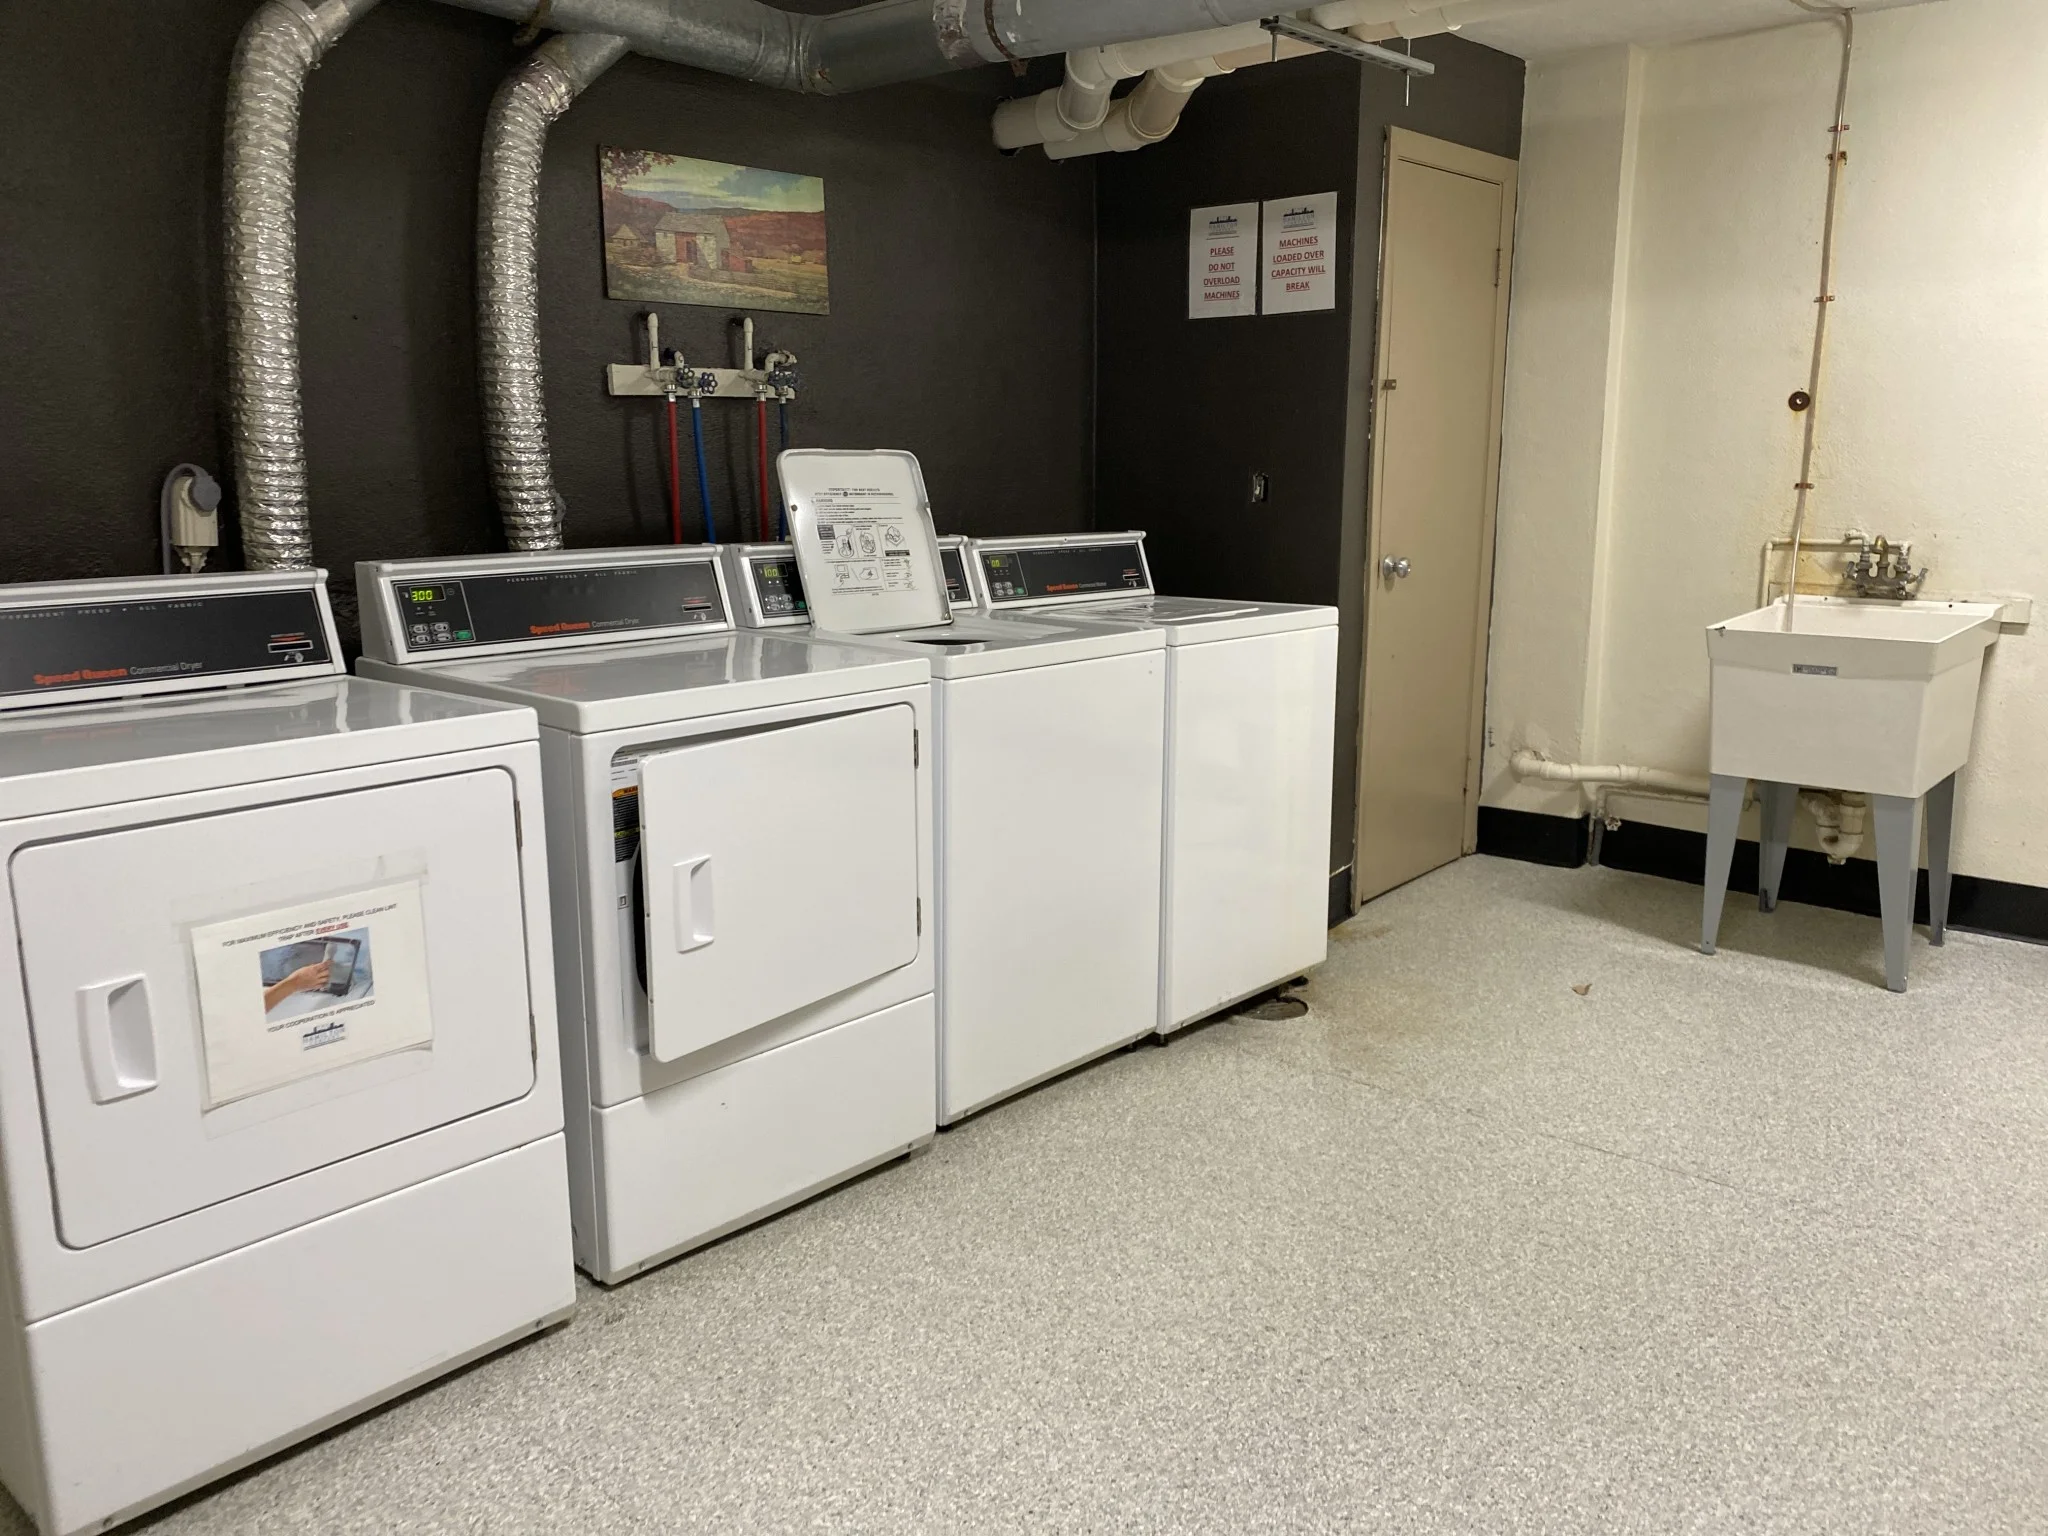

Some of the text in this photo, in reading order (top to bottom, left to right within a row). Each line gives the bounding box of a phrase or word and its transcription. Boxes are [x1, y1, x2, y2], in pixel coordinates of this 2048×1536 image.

[1279, 236, 1318, 248] MACHINES
[1210, 247, 1234, 256] PLEASE
[1272, 250, 1325, 263] LOADED OVER
[1208, 262, 1235, 271] DO NOT
[1271, 265, 1326, 278] CAPACITY WILL
[1203, 276, 1240, 286] OVERLOAD
[1285, 281, 1310, 291] BREAK
[1203, 291, 1240, 300] MACHINES
[411, 590, 433, 601] 300
[530, 623, 560, 635] Speed
[560, 622, 591, 631] Queen
[592, 619, 624, 628] Commercial
[34, 662, 203, 686] Speed Queen Commercial Dryer
